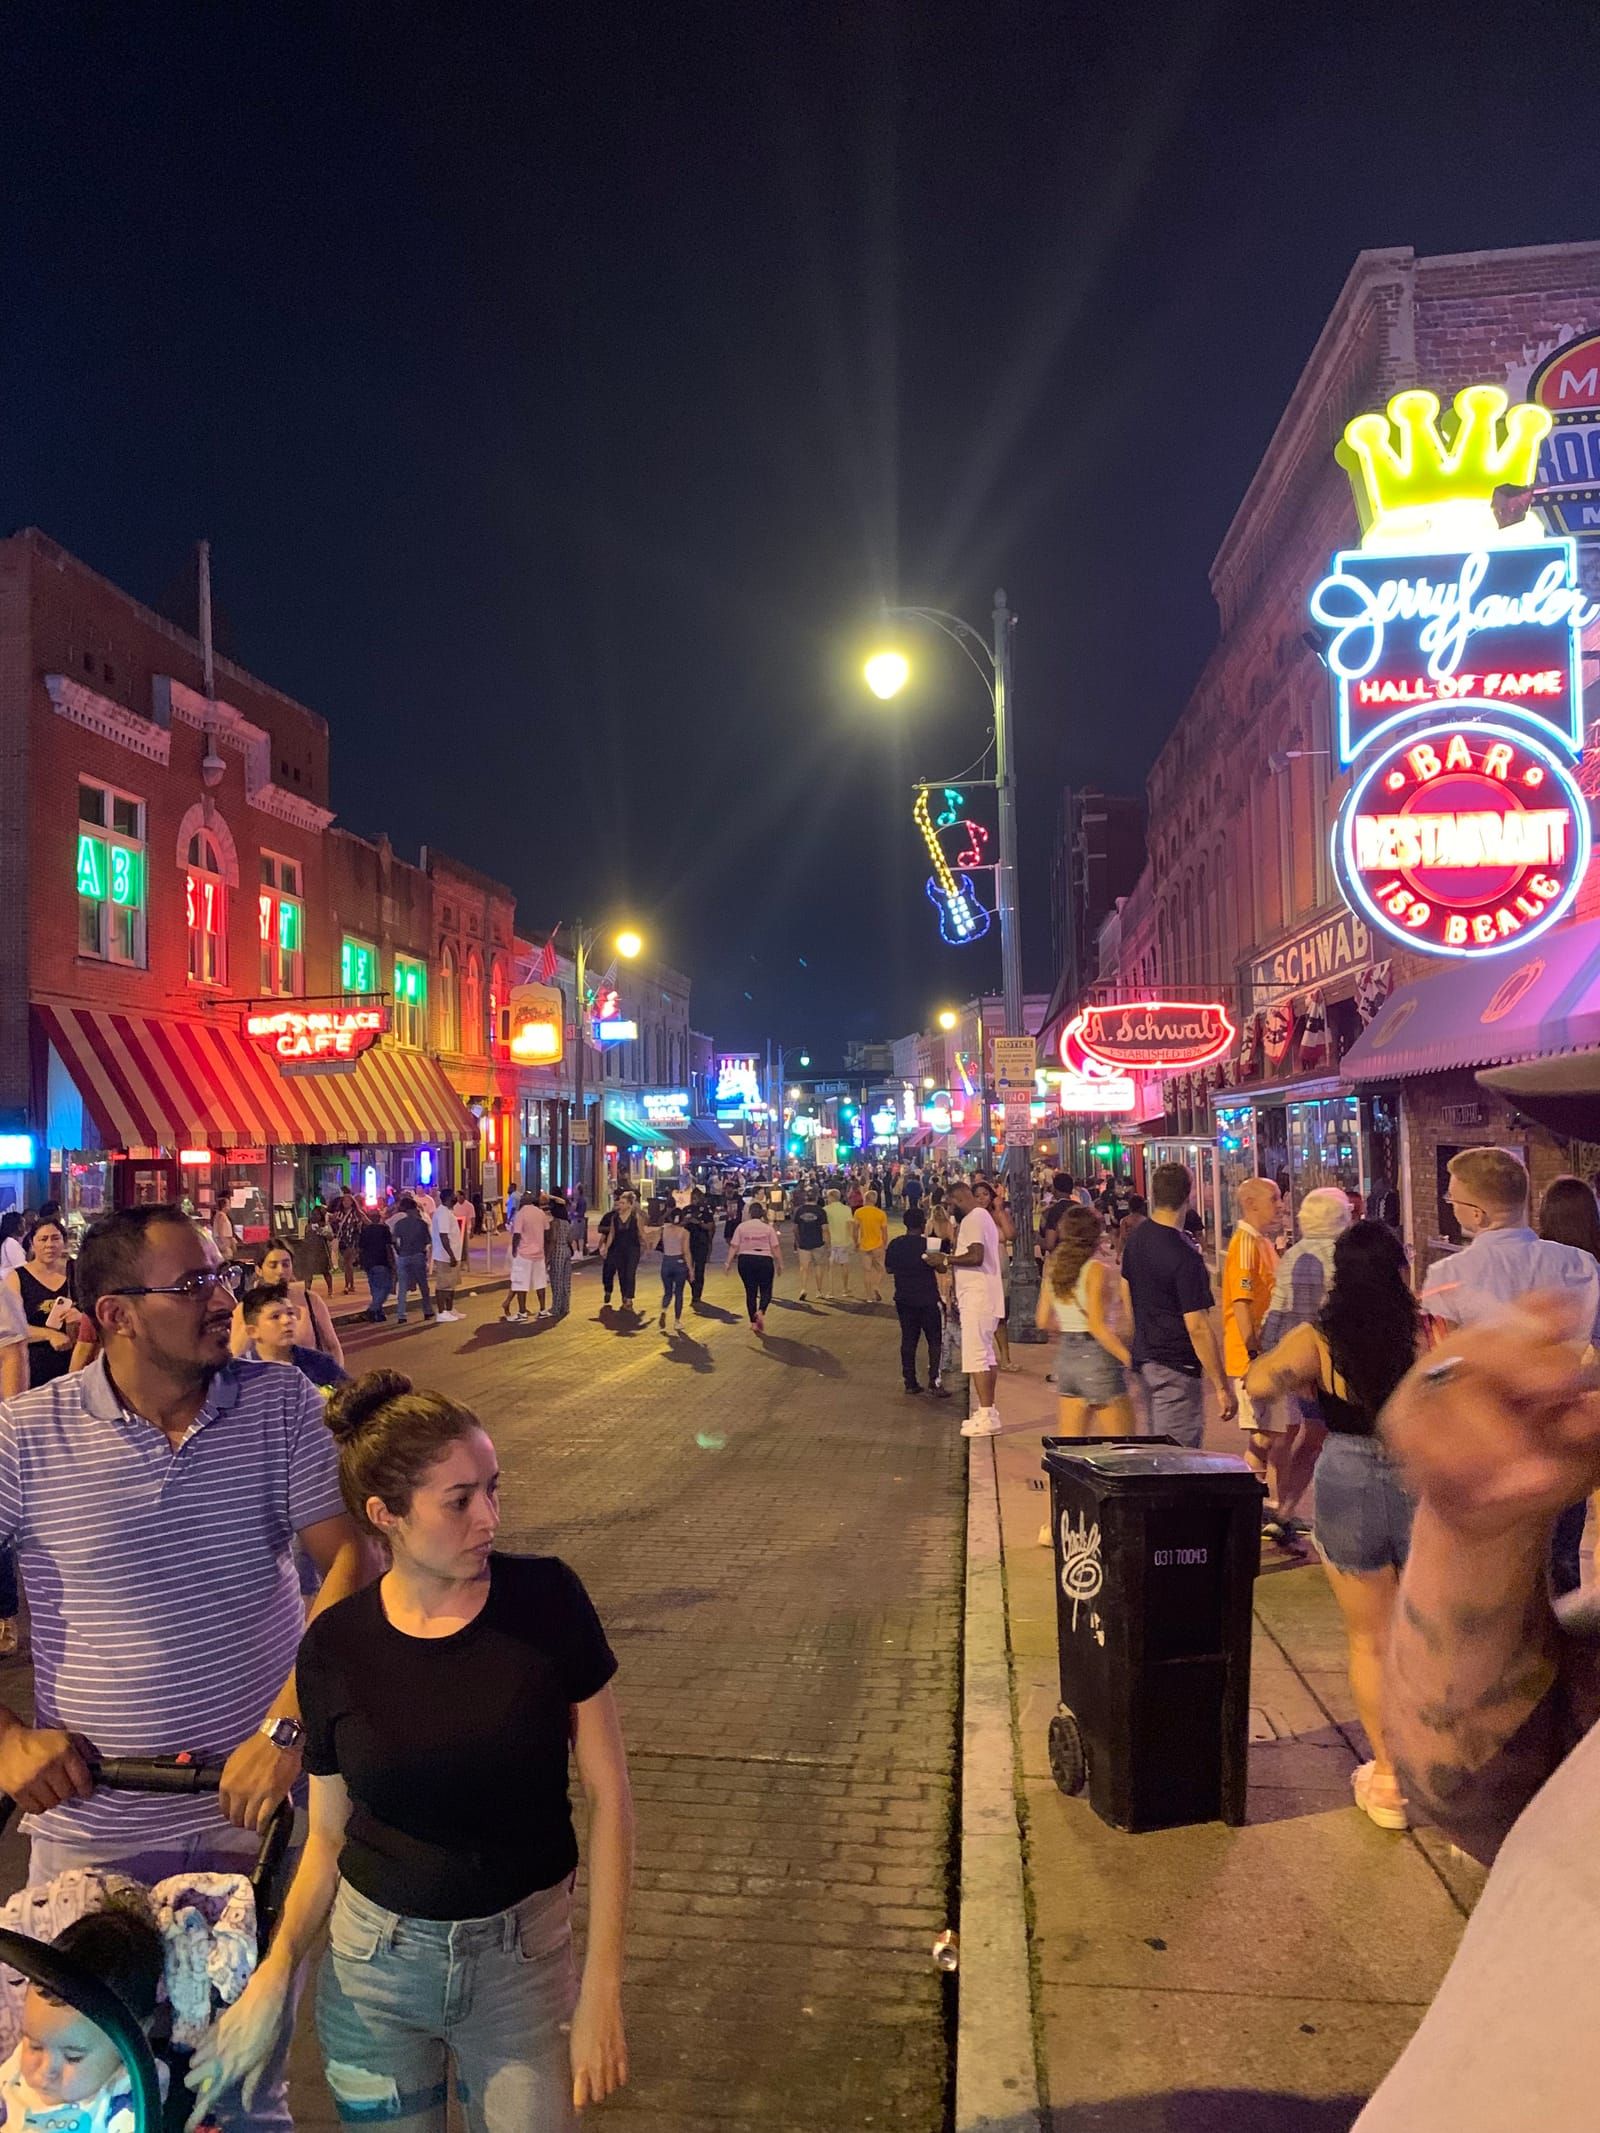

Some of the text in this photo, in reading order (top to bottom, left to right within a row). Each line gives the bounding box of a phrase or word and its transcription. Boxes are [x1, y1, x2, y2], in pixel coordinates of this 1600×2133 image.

[1310, 574, 1460, 680] Jerry
[1359, 670, 1563, 703] HALL OF FAME
[1407, 734, 1514, 781] BAR
[1355, 808, 1570, 871] RESTAURANT
[1376, 873, 1561, 944] 159 BEALE
[1273, 915, 1369, 988] SCHWAB
[276, 1032, 354, 1056] CAFE
[1083, 1010, 1225, 1042] A. Schwab
[1110, 1048, 1180, 1060] ESTABLISHED
[1009, 1092, 1026, 1102] NO
